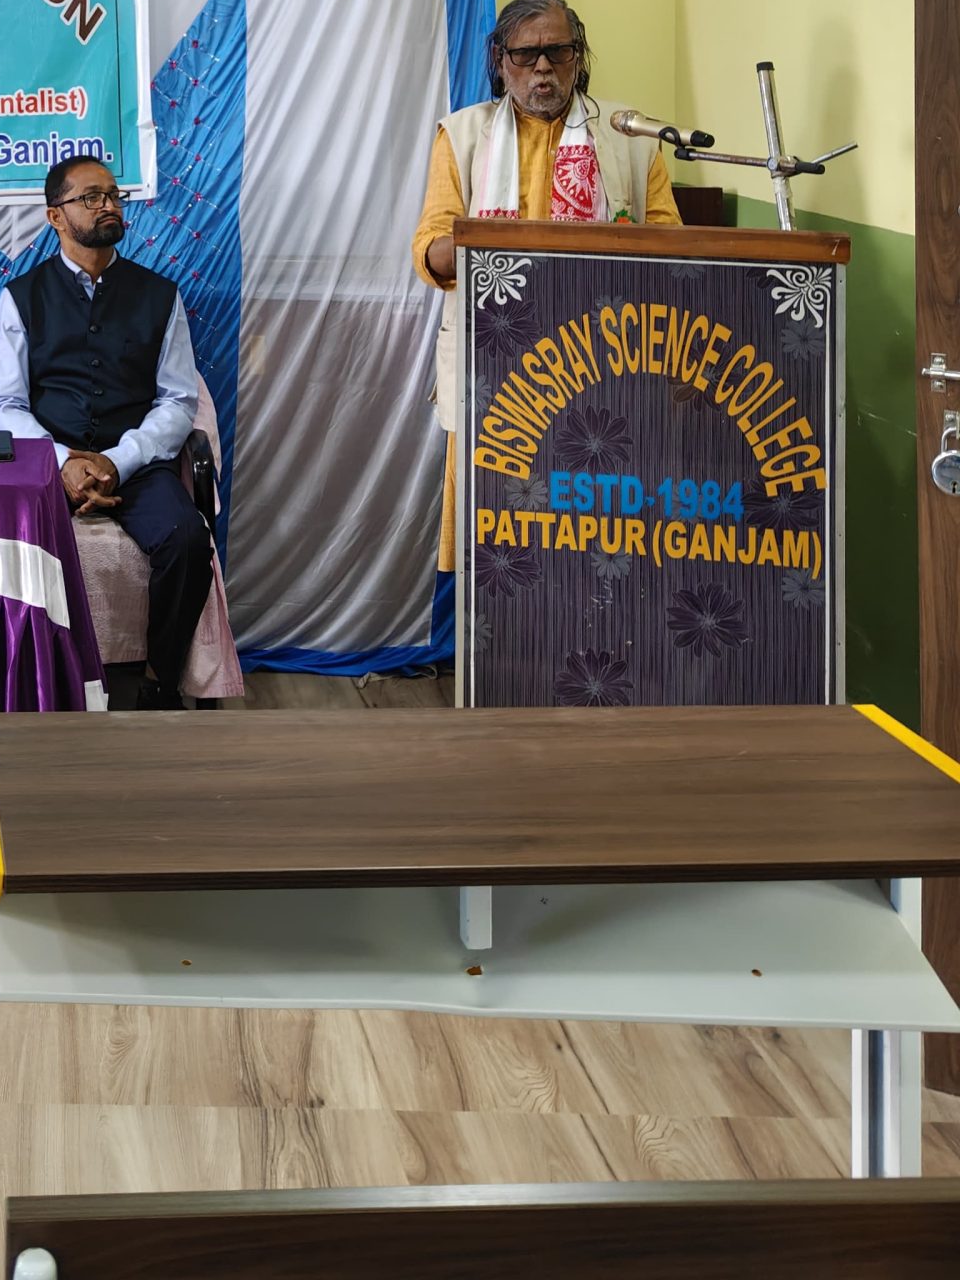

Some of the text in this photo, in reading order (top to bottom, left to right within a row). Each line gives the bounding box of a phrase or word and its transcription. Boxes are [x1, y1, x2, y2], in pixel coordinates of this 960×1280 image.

[473, 302, 828, 498] BISWASRAY SCIENCE COLLEGE
[476, 508, 823, 581] PATTAPUR (GANJAM)
